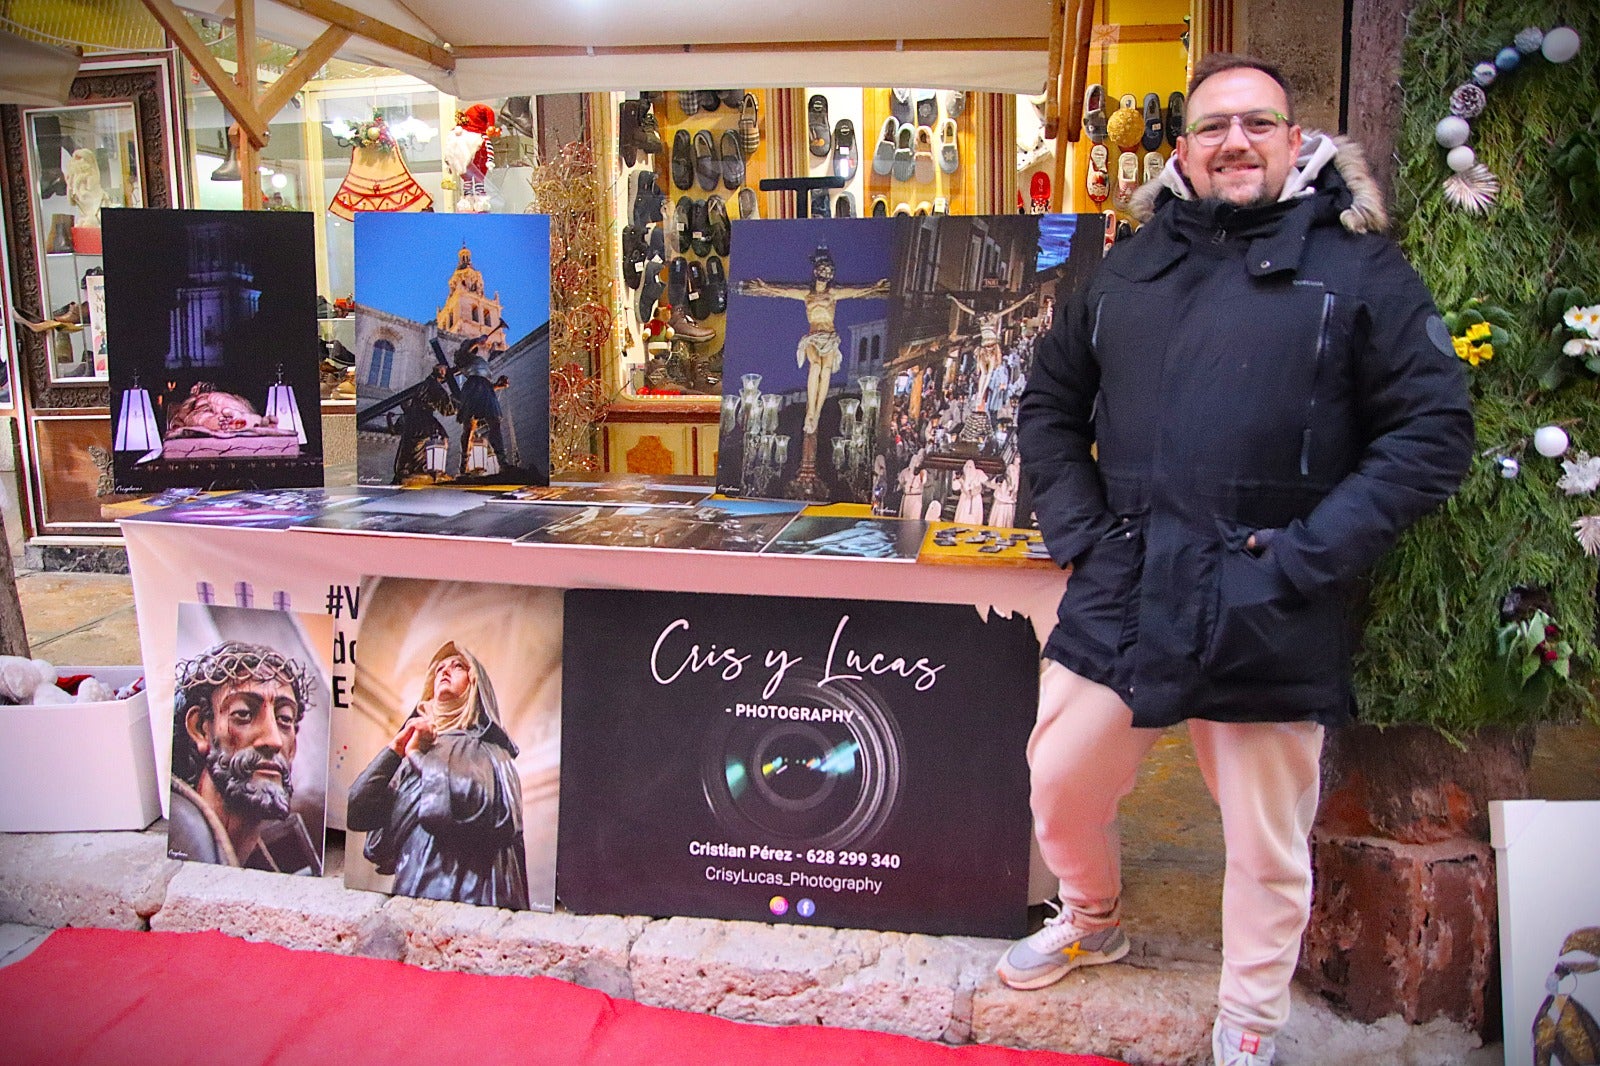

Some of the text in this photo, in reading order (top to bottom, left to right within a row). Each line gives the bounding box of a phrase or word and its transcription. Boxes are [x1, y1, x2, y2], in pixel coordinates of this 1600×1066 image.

[650, 615, 946, 700] Cris y Lucas
[735, 703, 854, 723] PHOTOGRAPHY
[689, 840, 746, 859] Cristian
[749, 844, 793, 862] Pérez
[806, 849, 835, 865] 628
[838, 852, 868, 867] 299
[871, 853, 901, 869] 340
[705, 866, 883, 895] CrisyLucas_Photography
